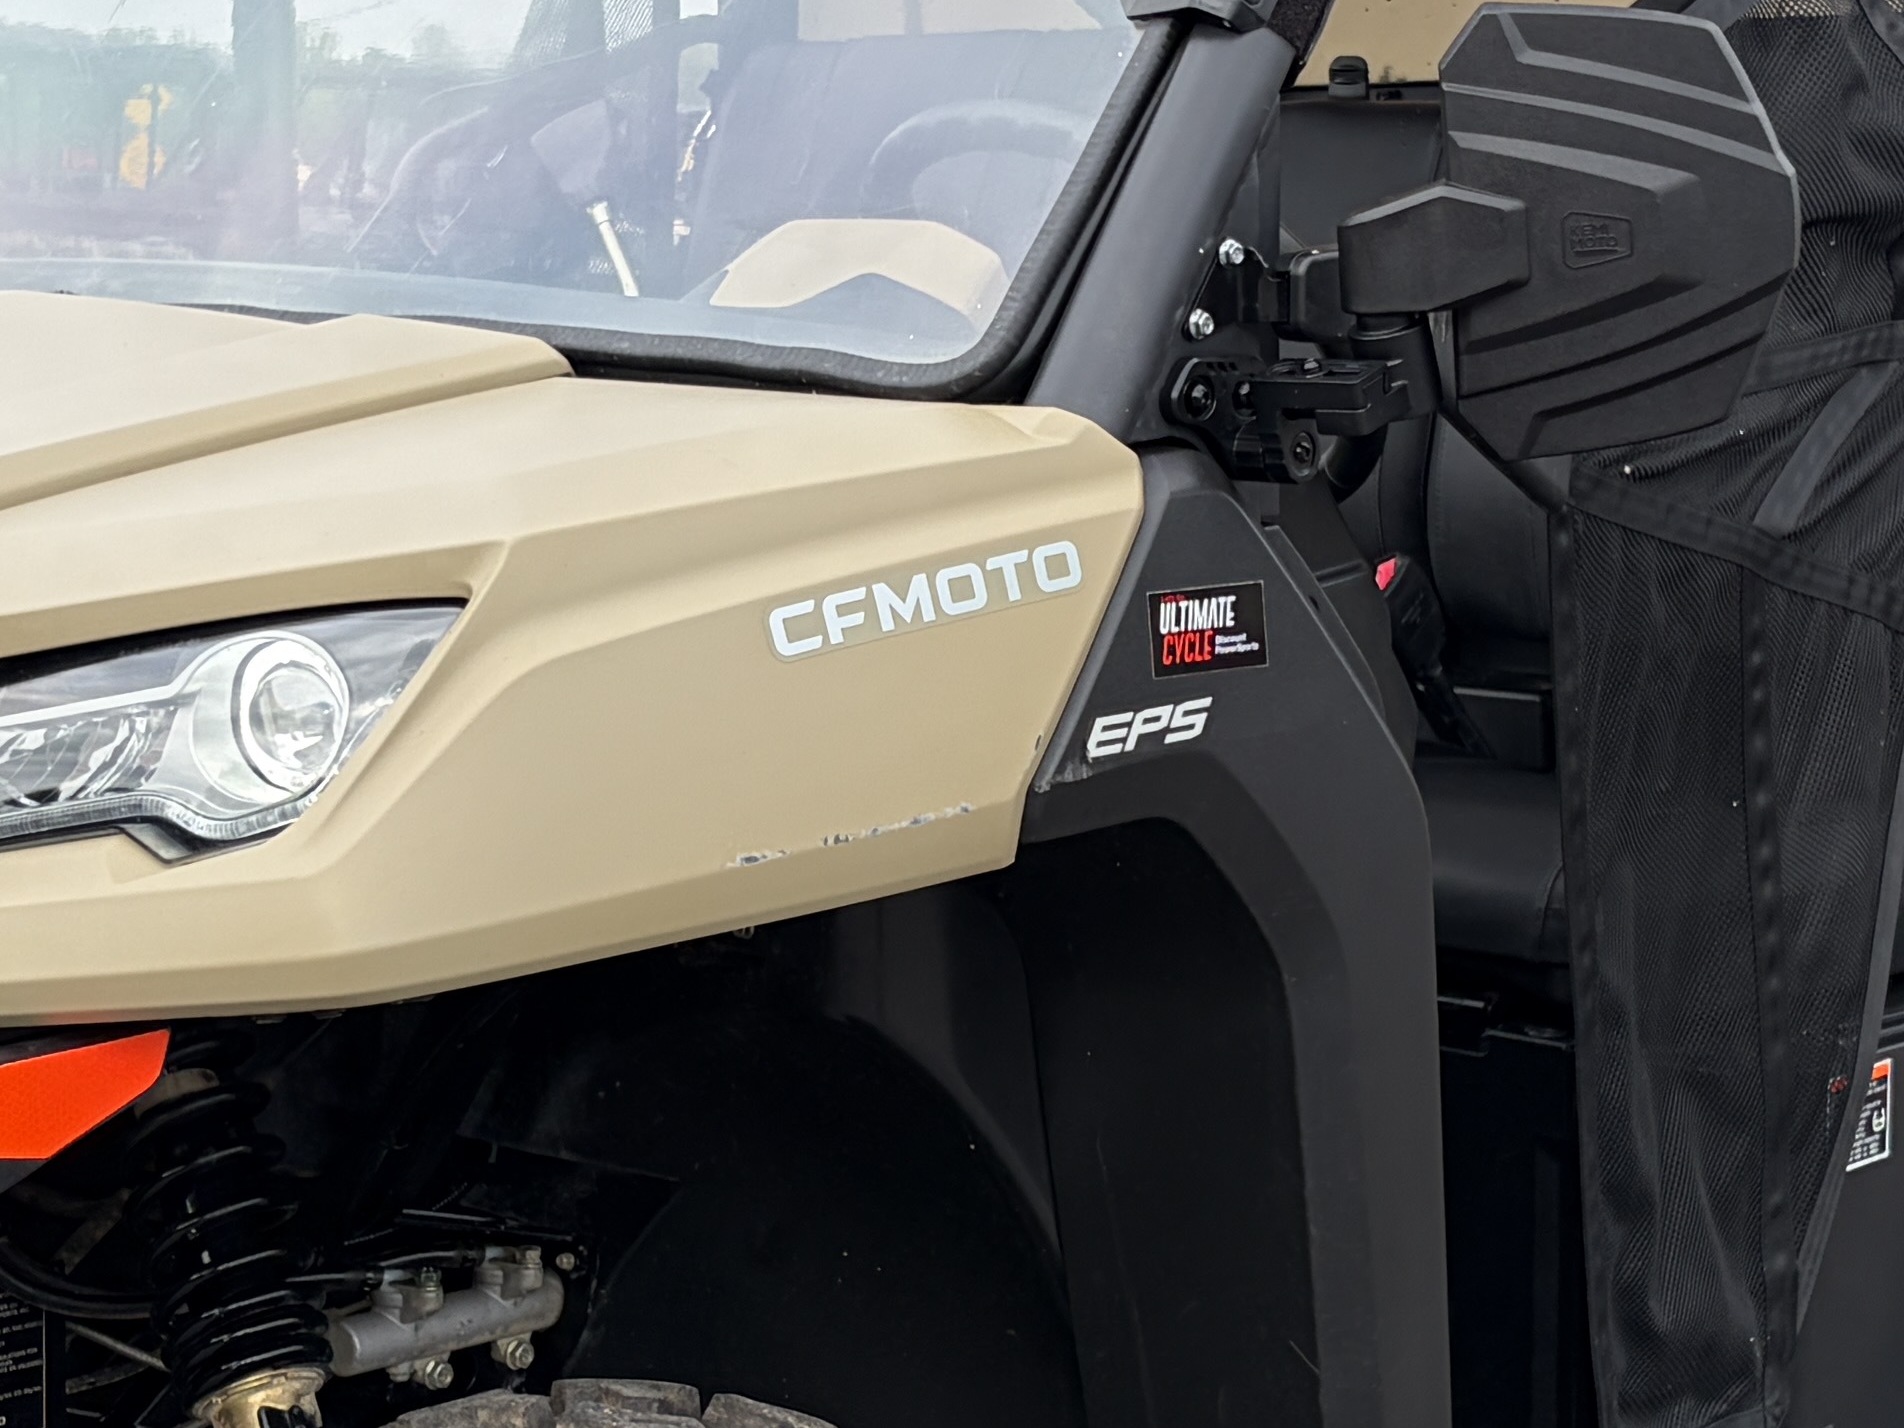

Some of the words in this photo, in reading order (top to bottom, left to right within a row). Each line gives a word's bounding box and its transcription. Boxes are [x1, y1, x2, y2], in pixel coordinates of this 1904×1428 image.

[769, 539, 1083, 657] CFMOTO
[1159, 595, 1236, 635] ULTIMATE
[1162, 630, 1214, 665] CYCLE
[1086, 697, 1213, 759] EPS
